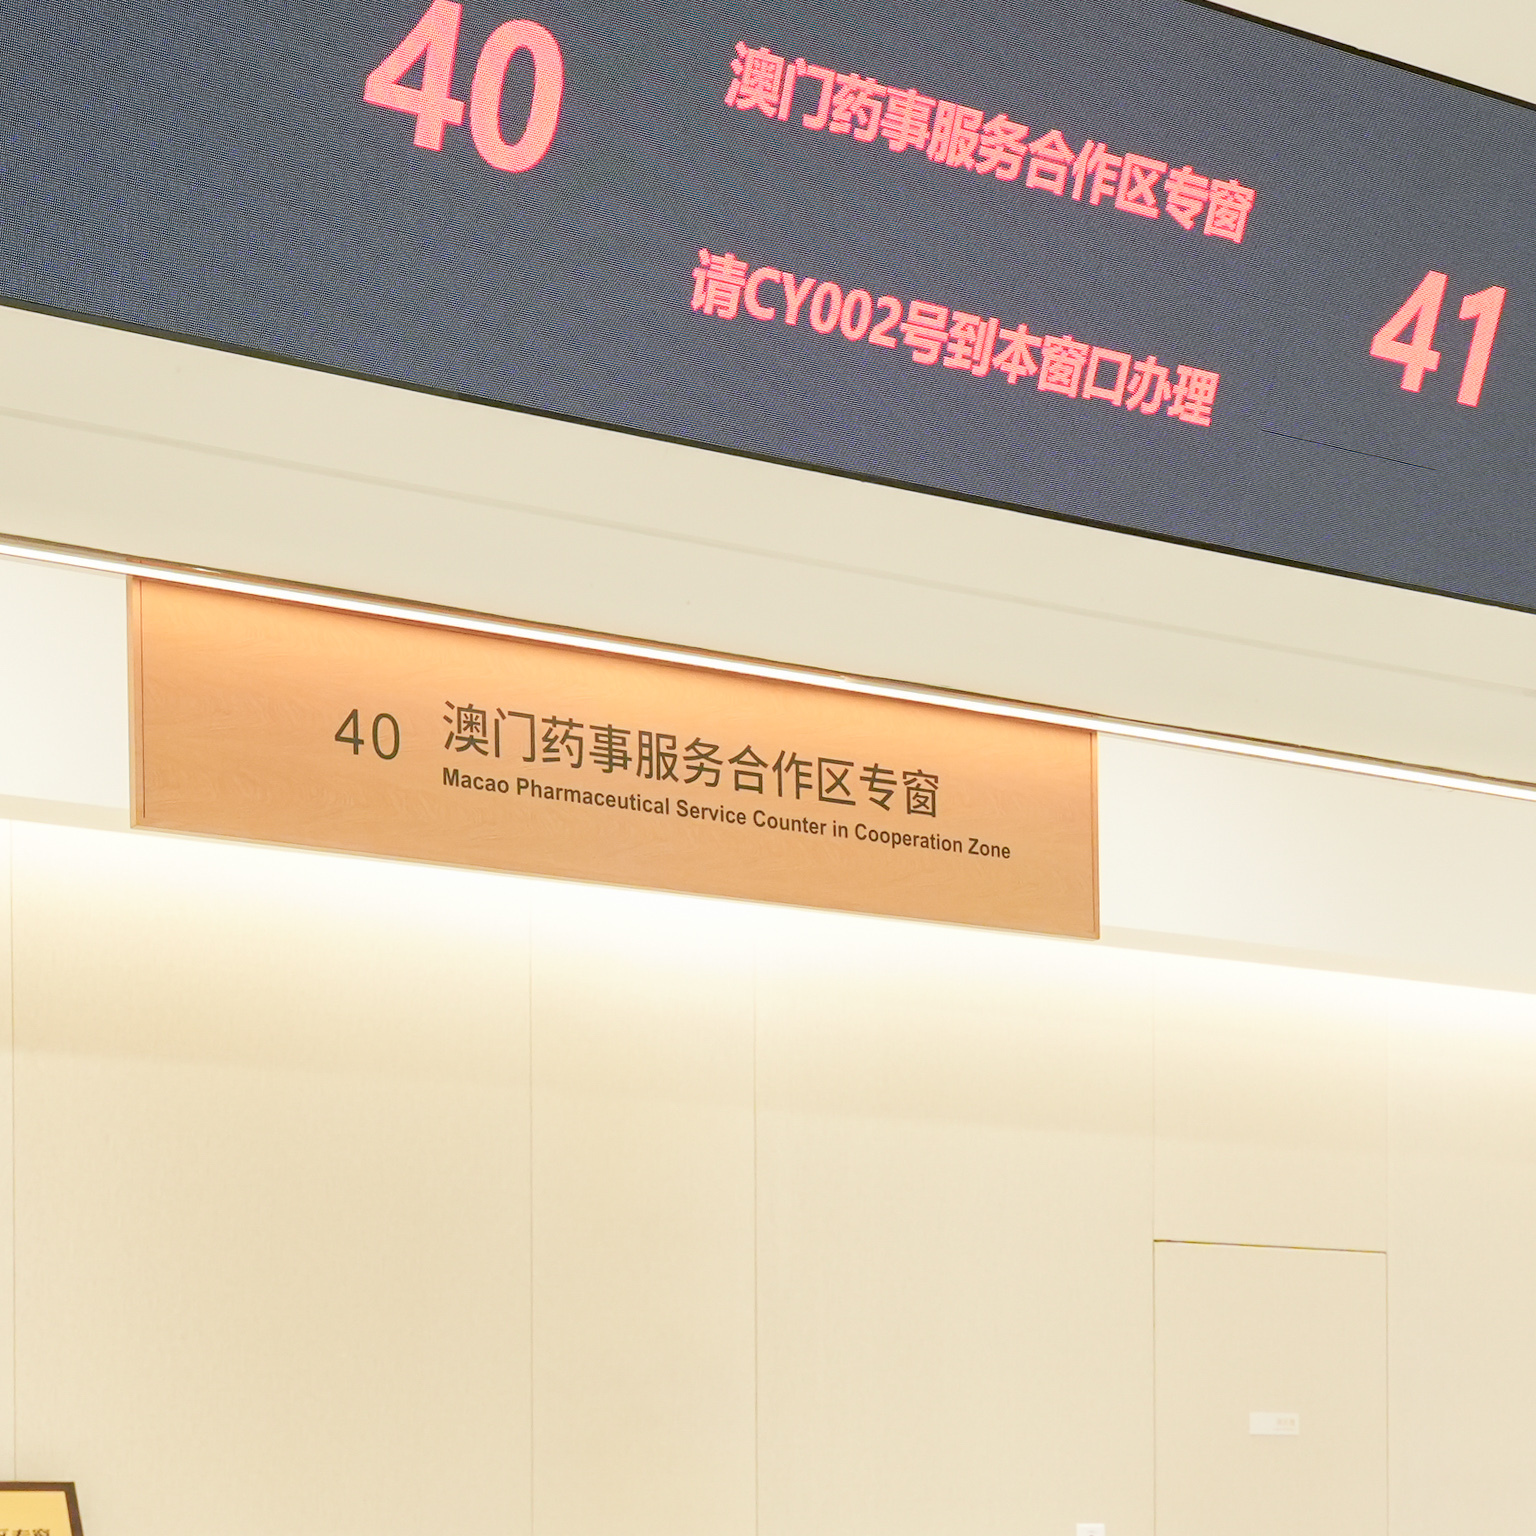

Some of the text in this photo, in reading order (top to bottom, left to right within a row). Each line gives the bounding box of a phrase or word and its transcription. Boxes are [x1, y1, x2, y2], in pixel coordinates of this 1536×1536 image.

[364, 0, 565, 173] 40
[724, 41, 1257, 244] 澳门药事服务合作区专窗
[690, 248, 1221, 428] 请CY002号到本窗口办理
[1369, 270, 1507, 407] 41
[334, 700, 940, 818] 40 澳门药事服务合作区专窗
[442, 766, 1011, 860] Macao Pharmaceutical Service Counter in Cooperation Zone
